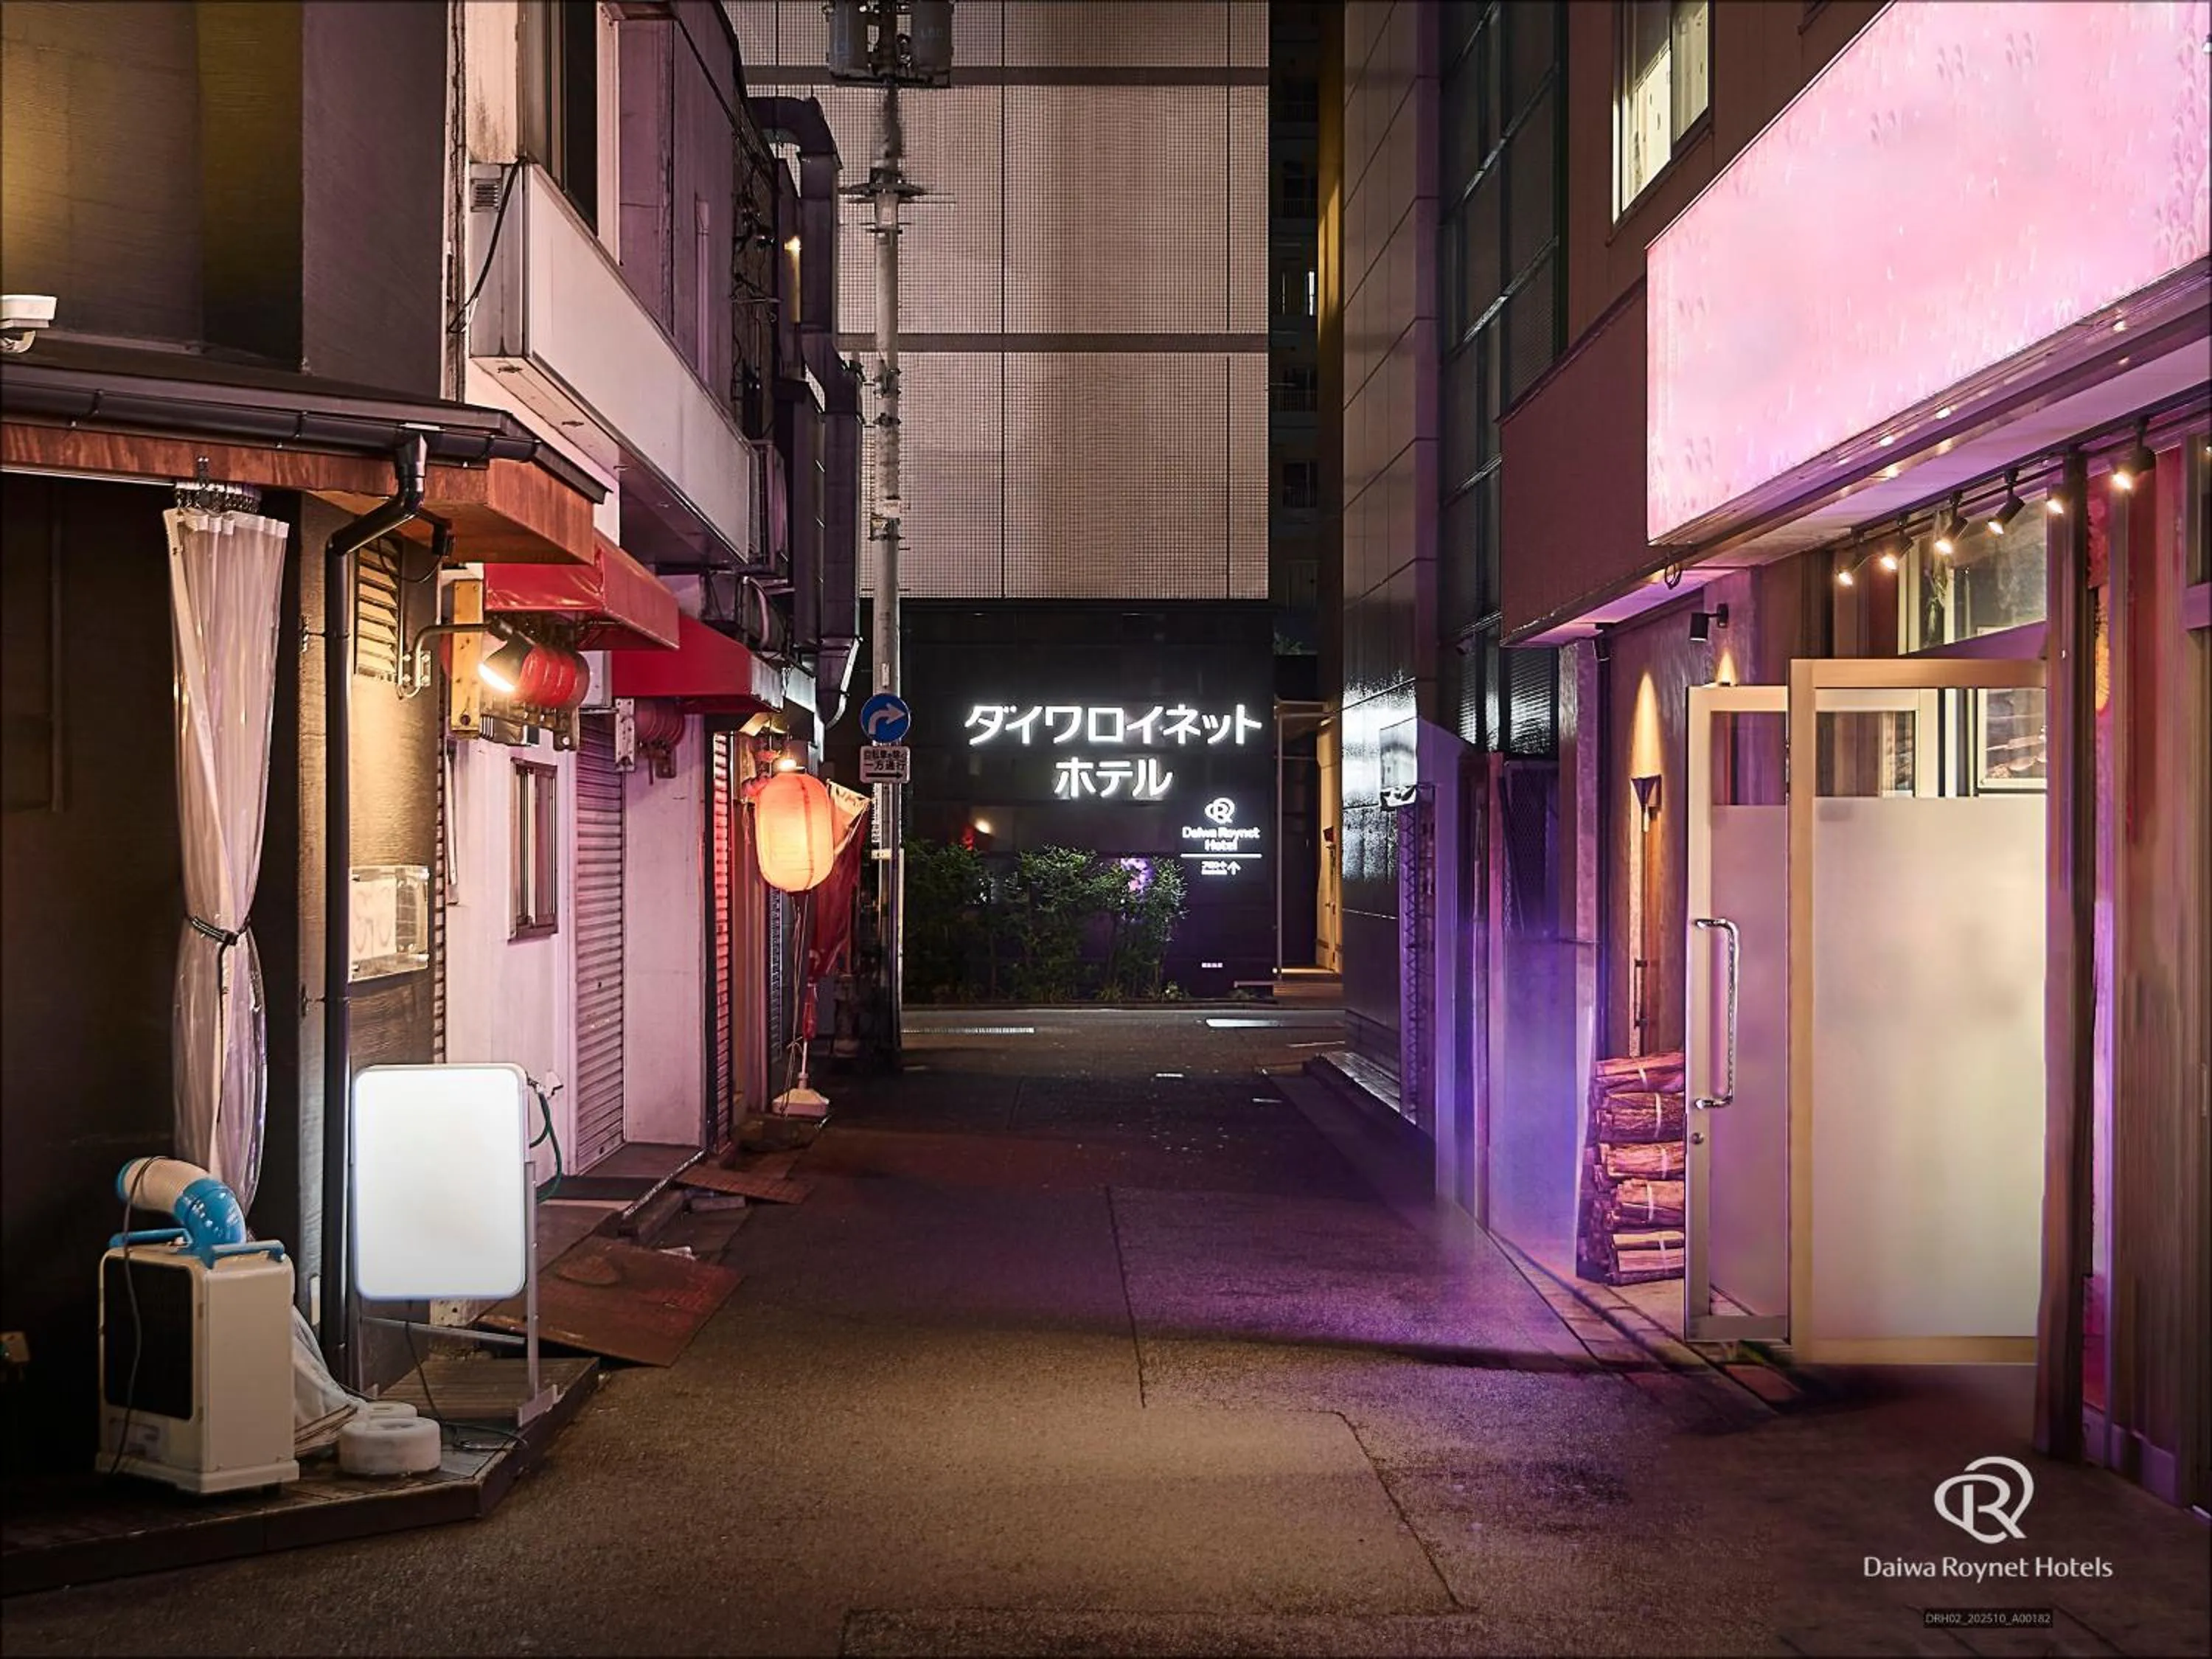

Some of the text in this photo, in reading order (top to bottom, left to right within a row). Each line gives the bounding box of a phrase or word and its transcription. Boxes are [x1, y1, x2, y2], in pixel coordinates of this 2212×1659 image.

[964, 703, 1262, 746] ダイワロイネット
[864, 759, 906, 771] 一方通行
[1054, 757, 1173, 800] ホテル
[1181, 826, 1217, 838] Daiwa
